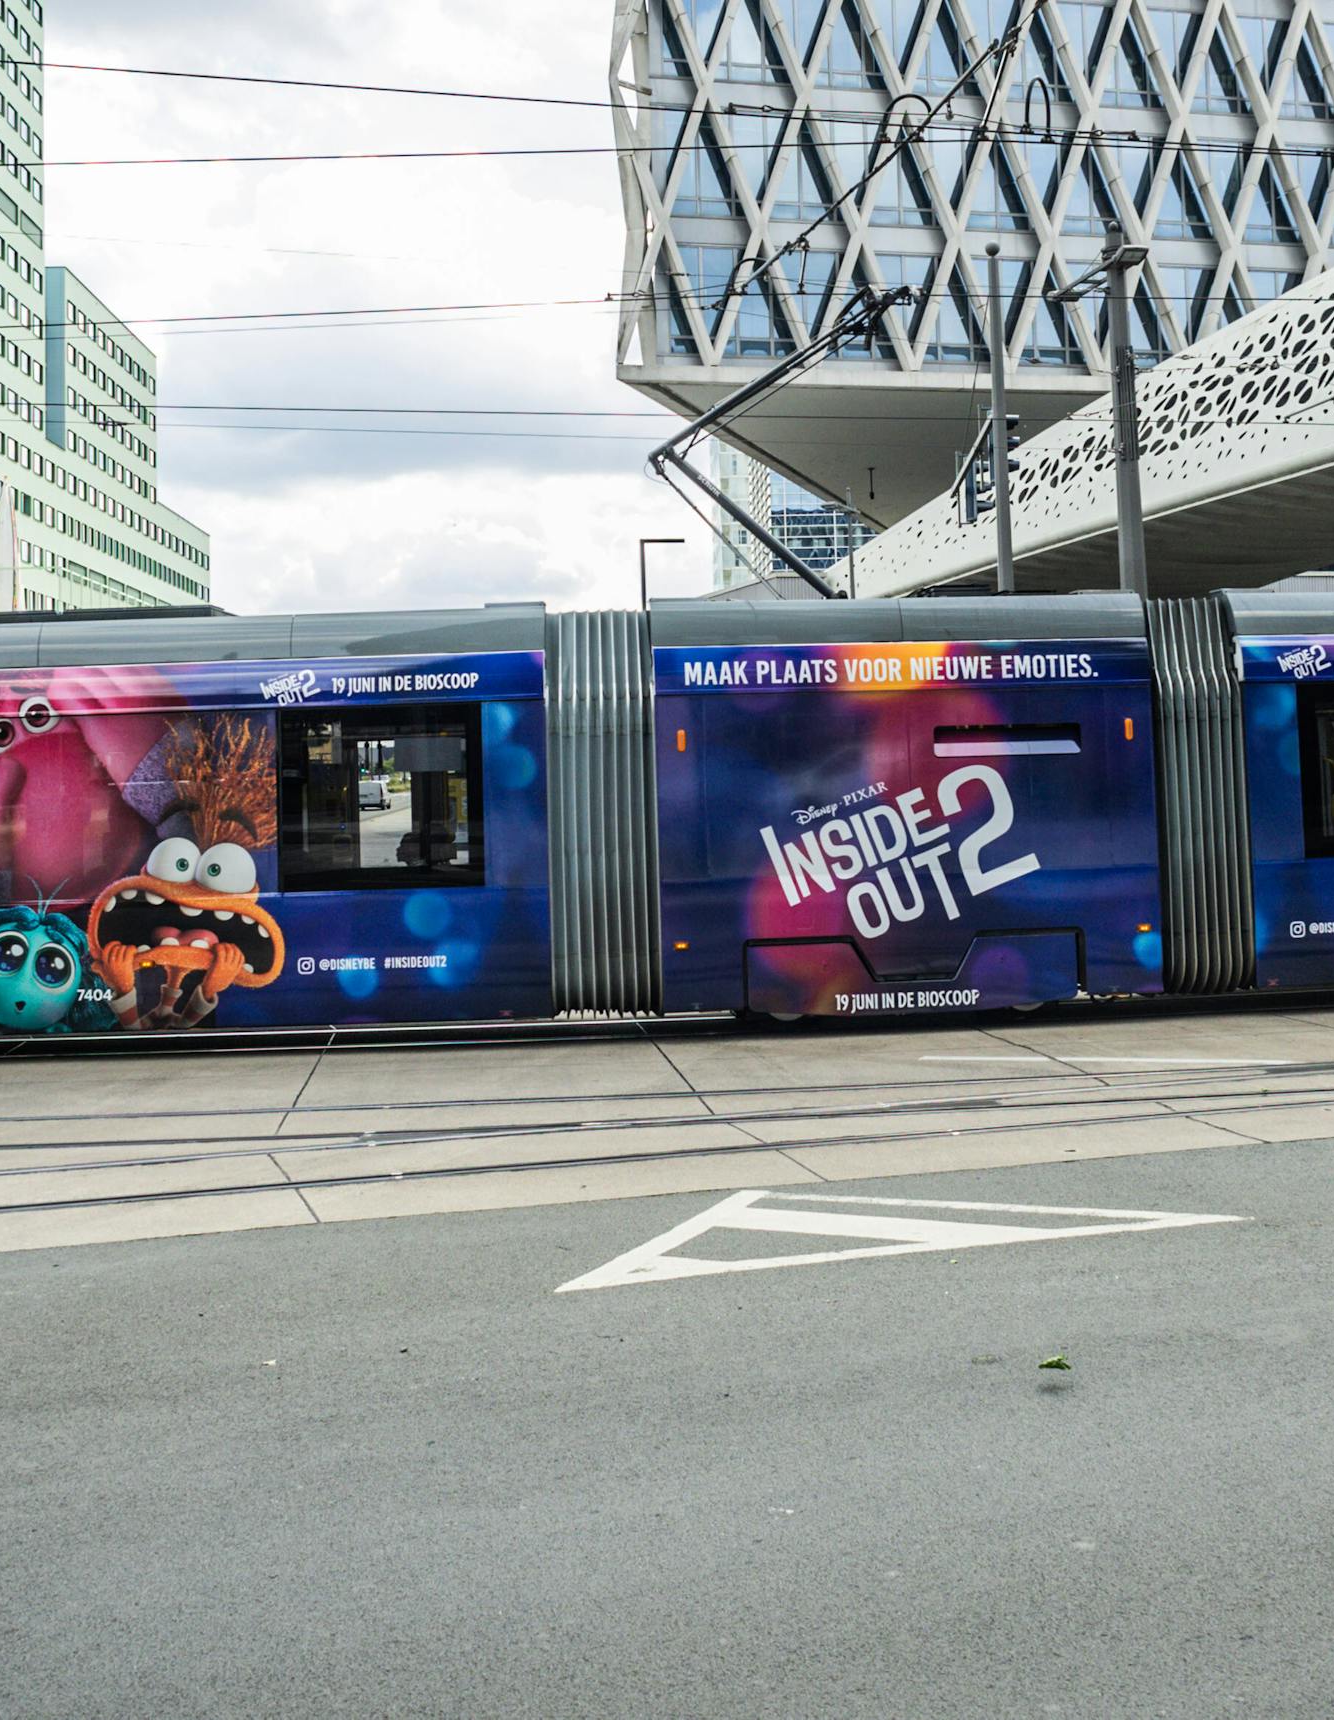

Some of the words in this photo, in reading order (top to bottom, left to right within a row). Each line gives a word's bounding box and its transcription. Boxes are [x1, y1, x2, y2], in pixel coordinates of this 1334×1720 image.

[683, 661, 748, 686] MAAK
[755, 659, 838, 684] PLAATS
[843, 658, 902, 682] VOOR
[910, 656, 993, 681] NIEUWE
[1000, 653, 1099, 679] EMOTIES.
[1276, 649, 1315, 673] INSIDE
[1293, 659, 1317, 680] OUT
[1309, 644, 1332, 672] 2
[259, 674, 302, 700] INSIDE
[277, 685, 303, 707] OUT
[298, 669, 321, 698] 2
[331, 677, 346, 694] 19
[347, 675, 376, 697] JUNI
[378, 675, 394, 692] IN
[395, 674, 412, 692] DE
[414, 672, 480, 691] BIOSCOOP
[842, 781, 888, 807] PIXAR
[759, 787, 950, 908] INSIDE
[846, 842, 960, 939] OUT
[937, 764, 1042, 897] 2
[319, 957, 376, 971] @DISNEYBE
[384, 955, 447, 969] #INSIDEOUT2
[77, 988, 113, 1002] 7404
[835, 994, 849, 1011] 19
[881, 992, 895, 1009] IN
[897, 992, 914, 1008] DE
[917, 989, 980, 1008] BIOSCOOP
